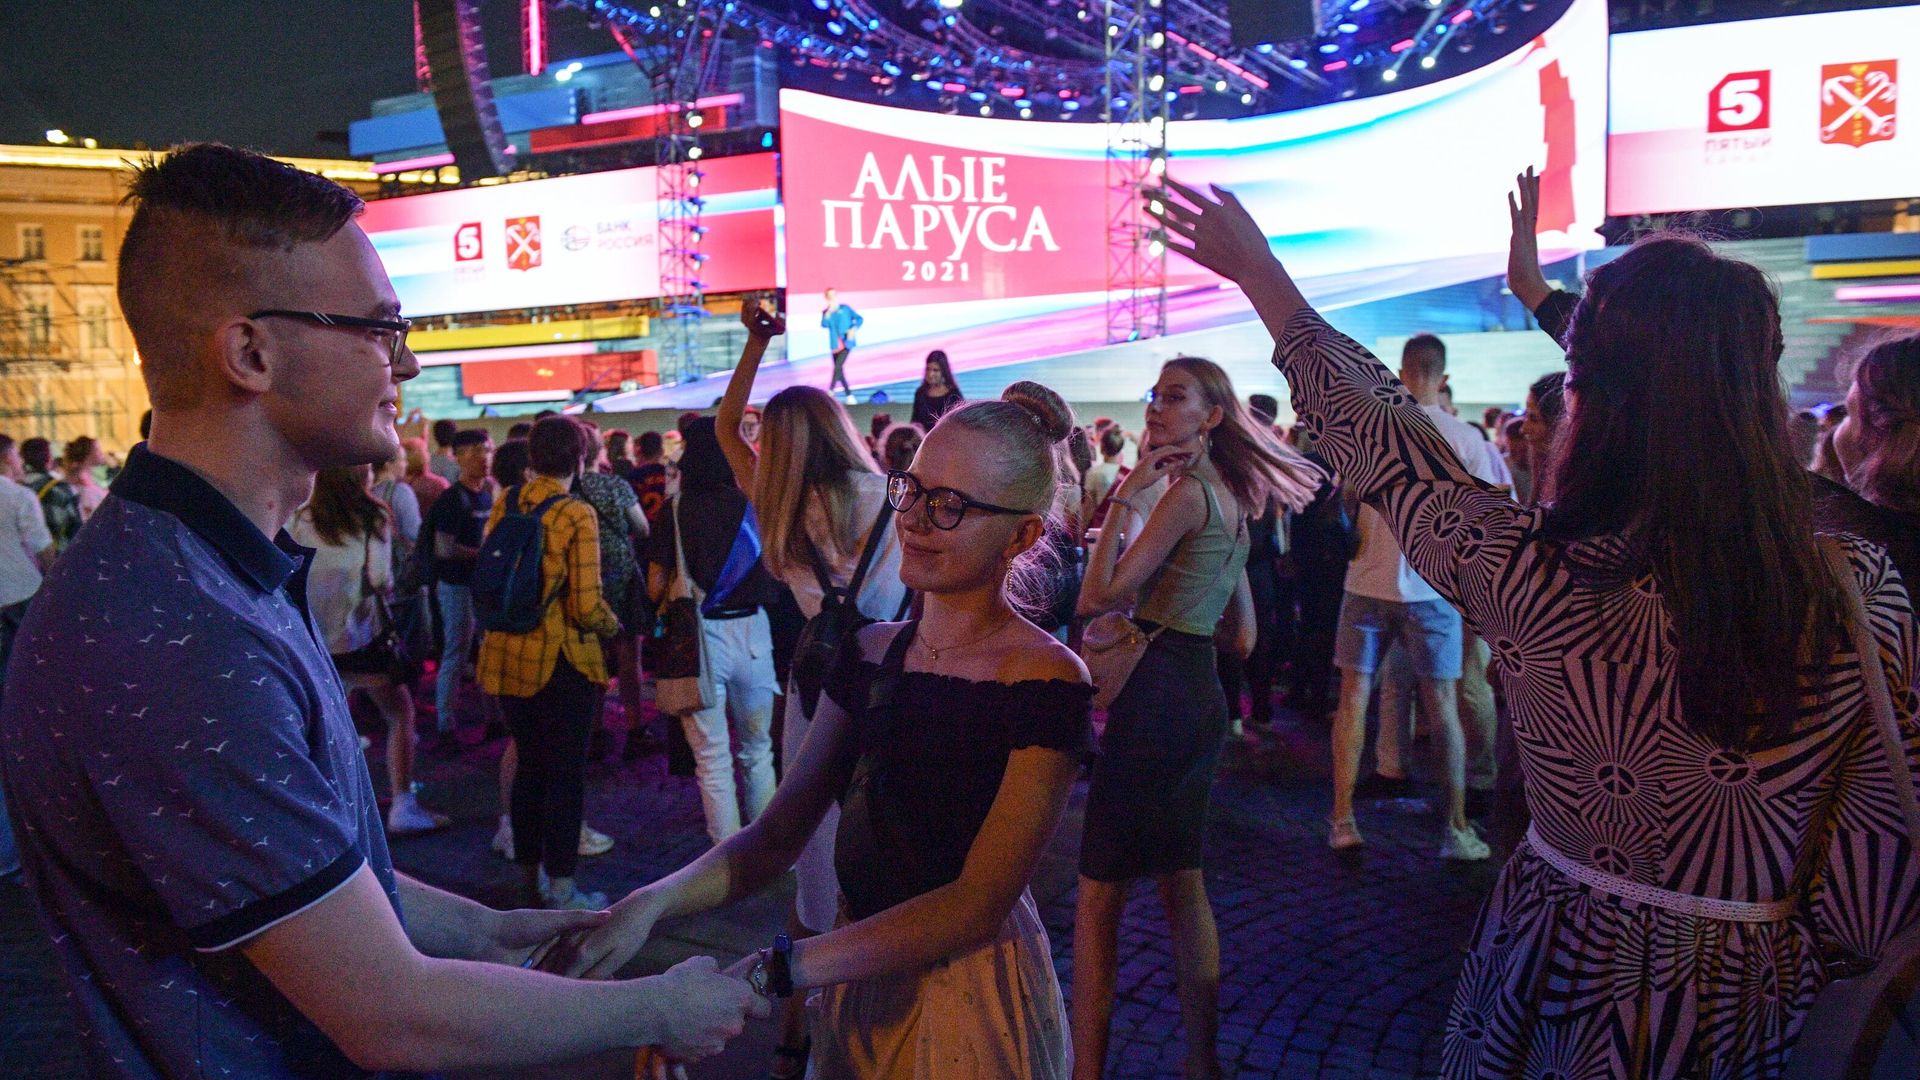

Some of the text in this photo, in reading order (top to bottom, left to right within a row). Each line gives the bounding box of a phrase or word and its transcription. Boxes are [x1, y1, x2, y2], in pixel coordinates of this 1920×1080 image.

[1717, 78, 1763, 126] 5
[849, 151, 1008, 204] АЛЫЕ
[458, 227, 480, 258] 5
[821, 199, 1061, 261] ПАРУСА
[901, 260, 970, 282] 2021
